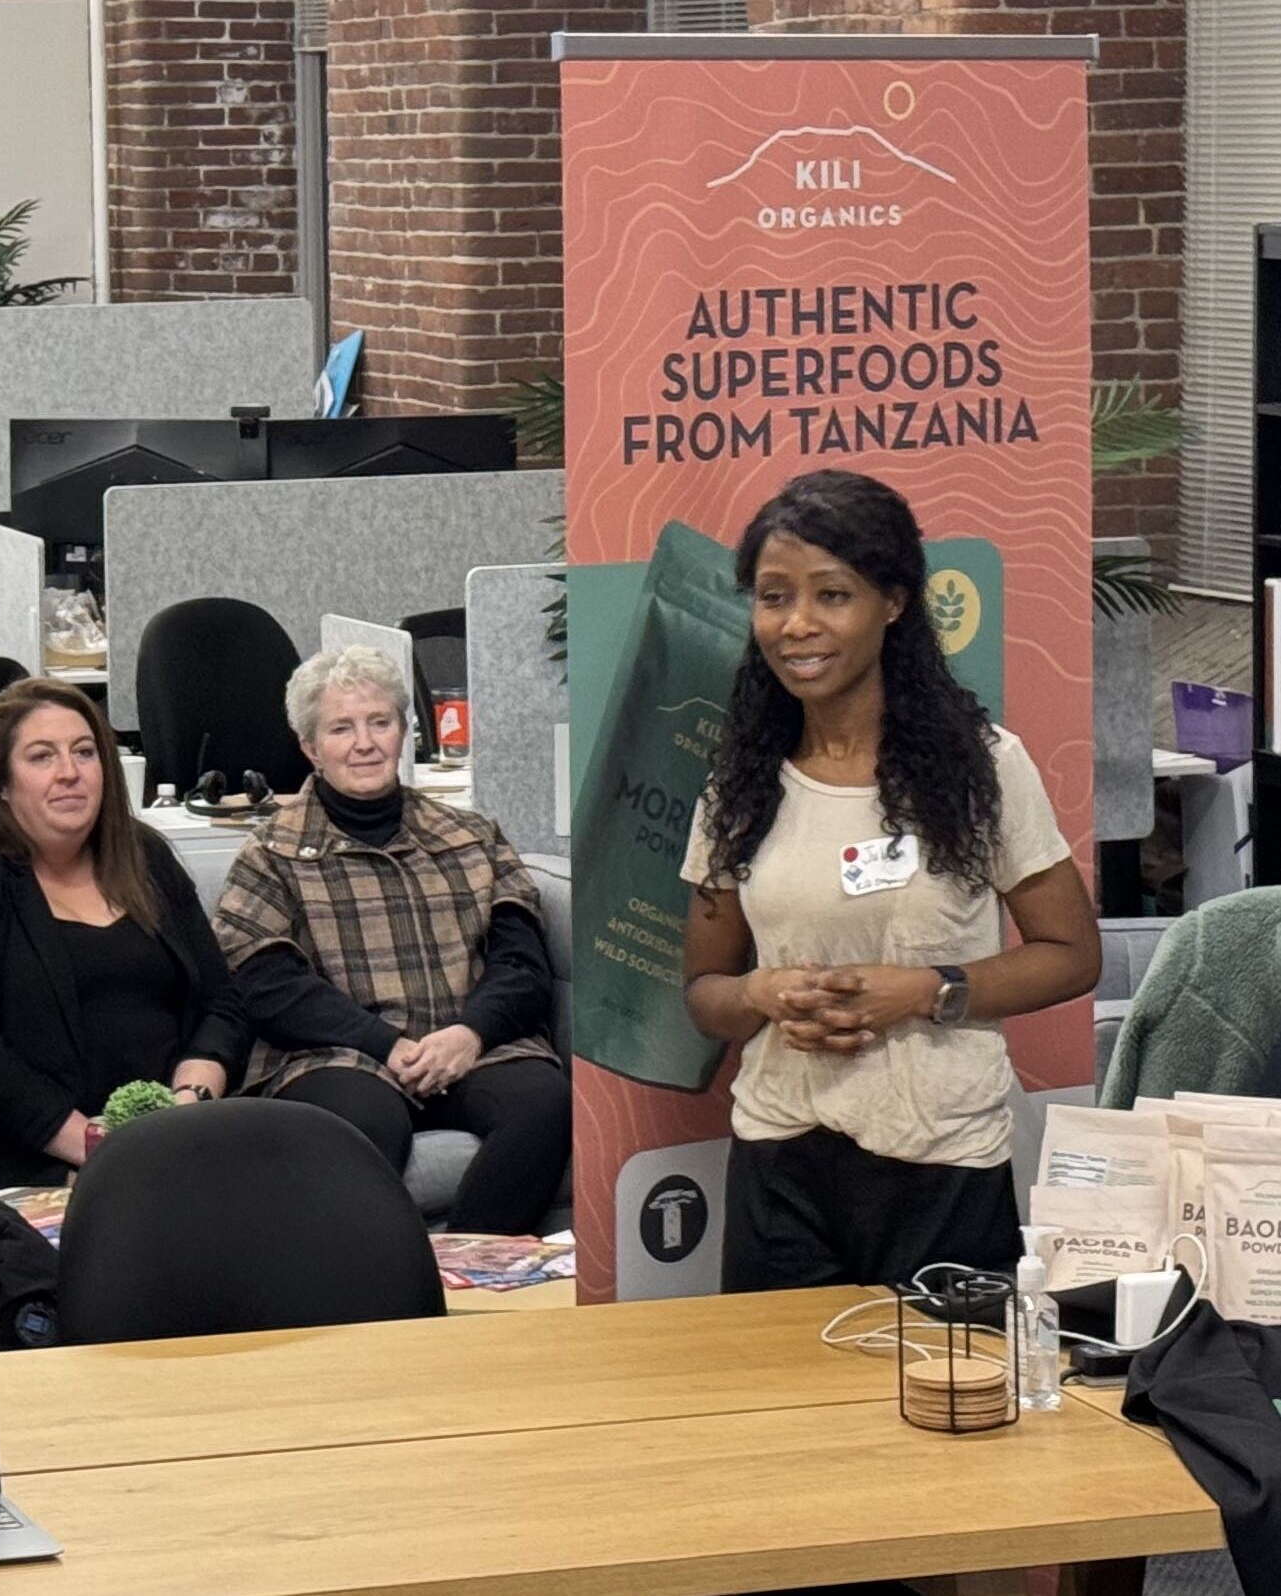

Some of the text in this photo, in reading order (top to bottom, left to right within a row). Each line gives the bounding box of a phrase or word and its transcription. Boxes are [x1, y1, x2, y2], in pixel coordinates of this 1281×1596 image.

[796, 159, 861, 190] KILI
[757, 204, 903, 230] ORGANICS
[686, 281, 979, 340] AUTHENTIC
[661, 339, 1003, 402] SUPERFOODS
[623, 397, 1040, 465] FROM TANZANIA
